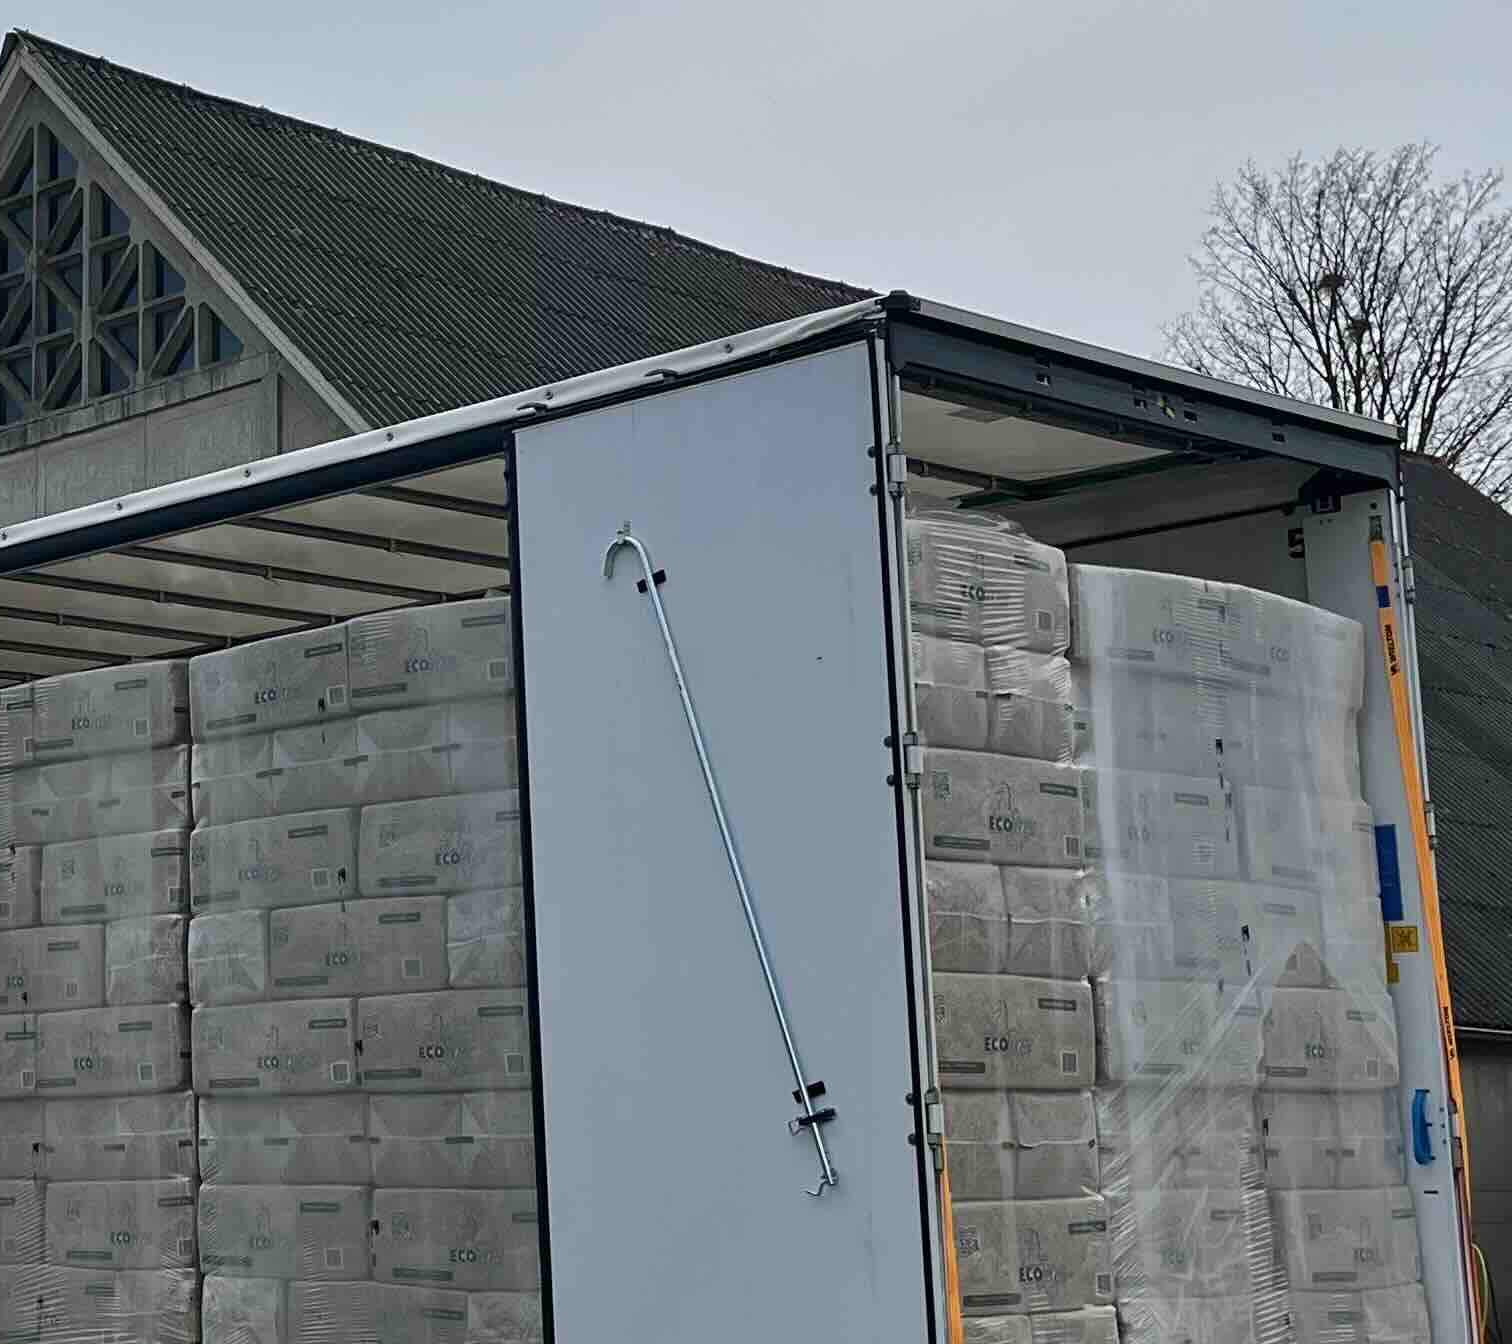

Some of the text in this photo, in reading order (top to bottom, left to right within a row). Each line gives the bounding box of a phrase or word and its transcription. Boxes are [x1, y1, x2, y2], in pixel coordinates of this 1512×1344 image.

[405, 659, 429, 673] ECO
[989, 816, 1013, 832] ECO
[419, 1045, 444, 1058] ECO
[984, 1037, 1009, 1052] ECO
[1019, 1267, 1043, 1282] ECO
